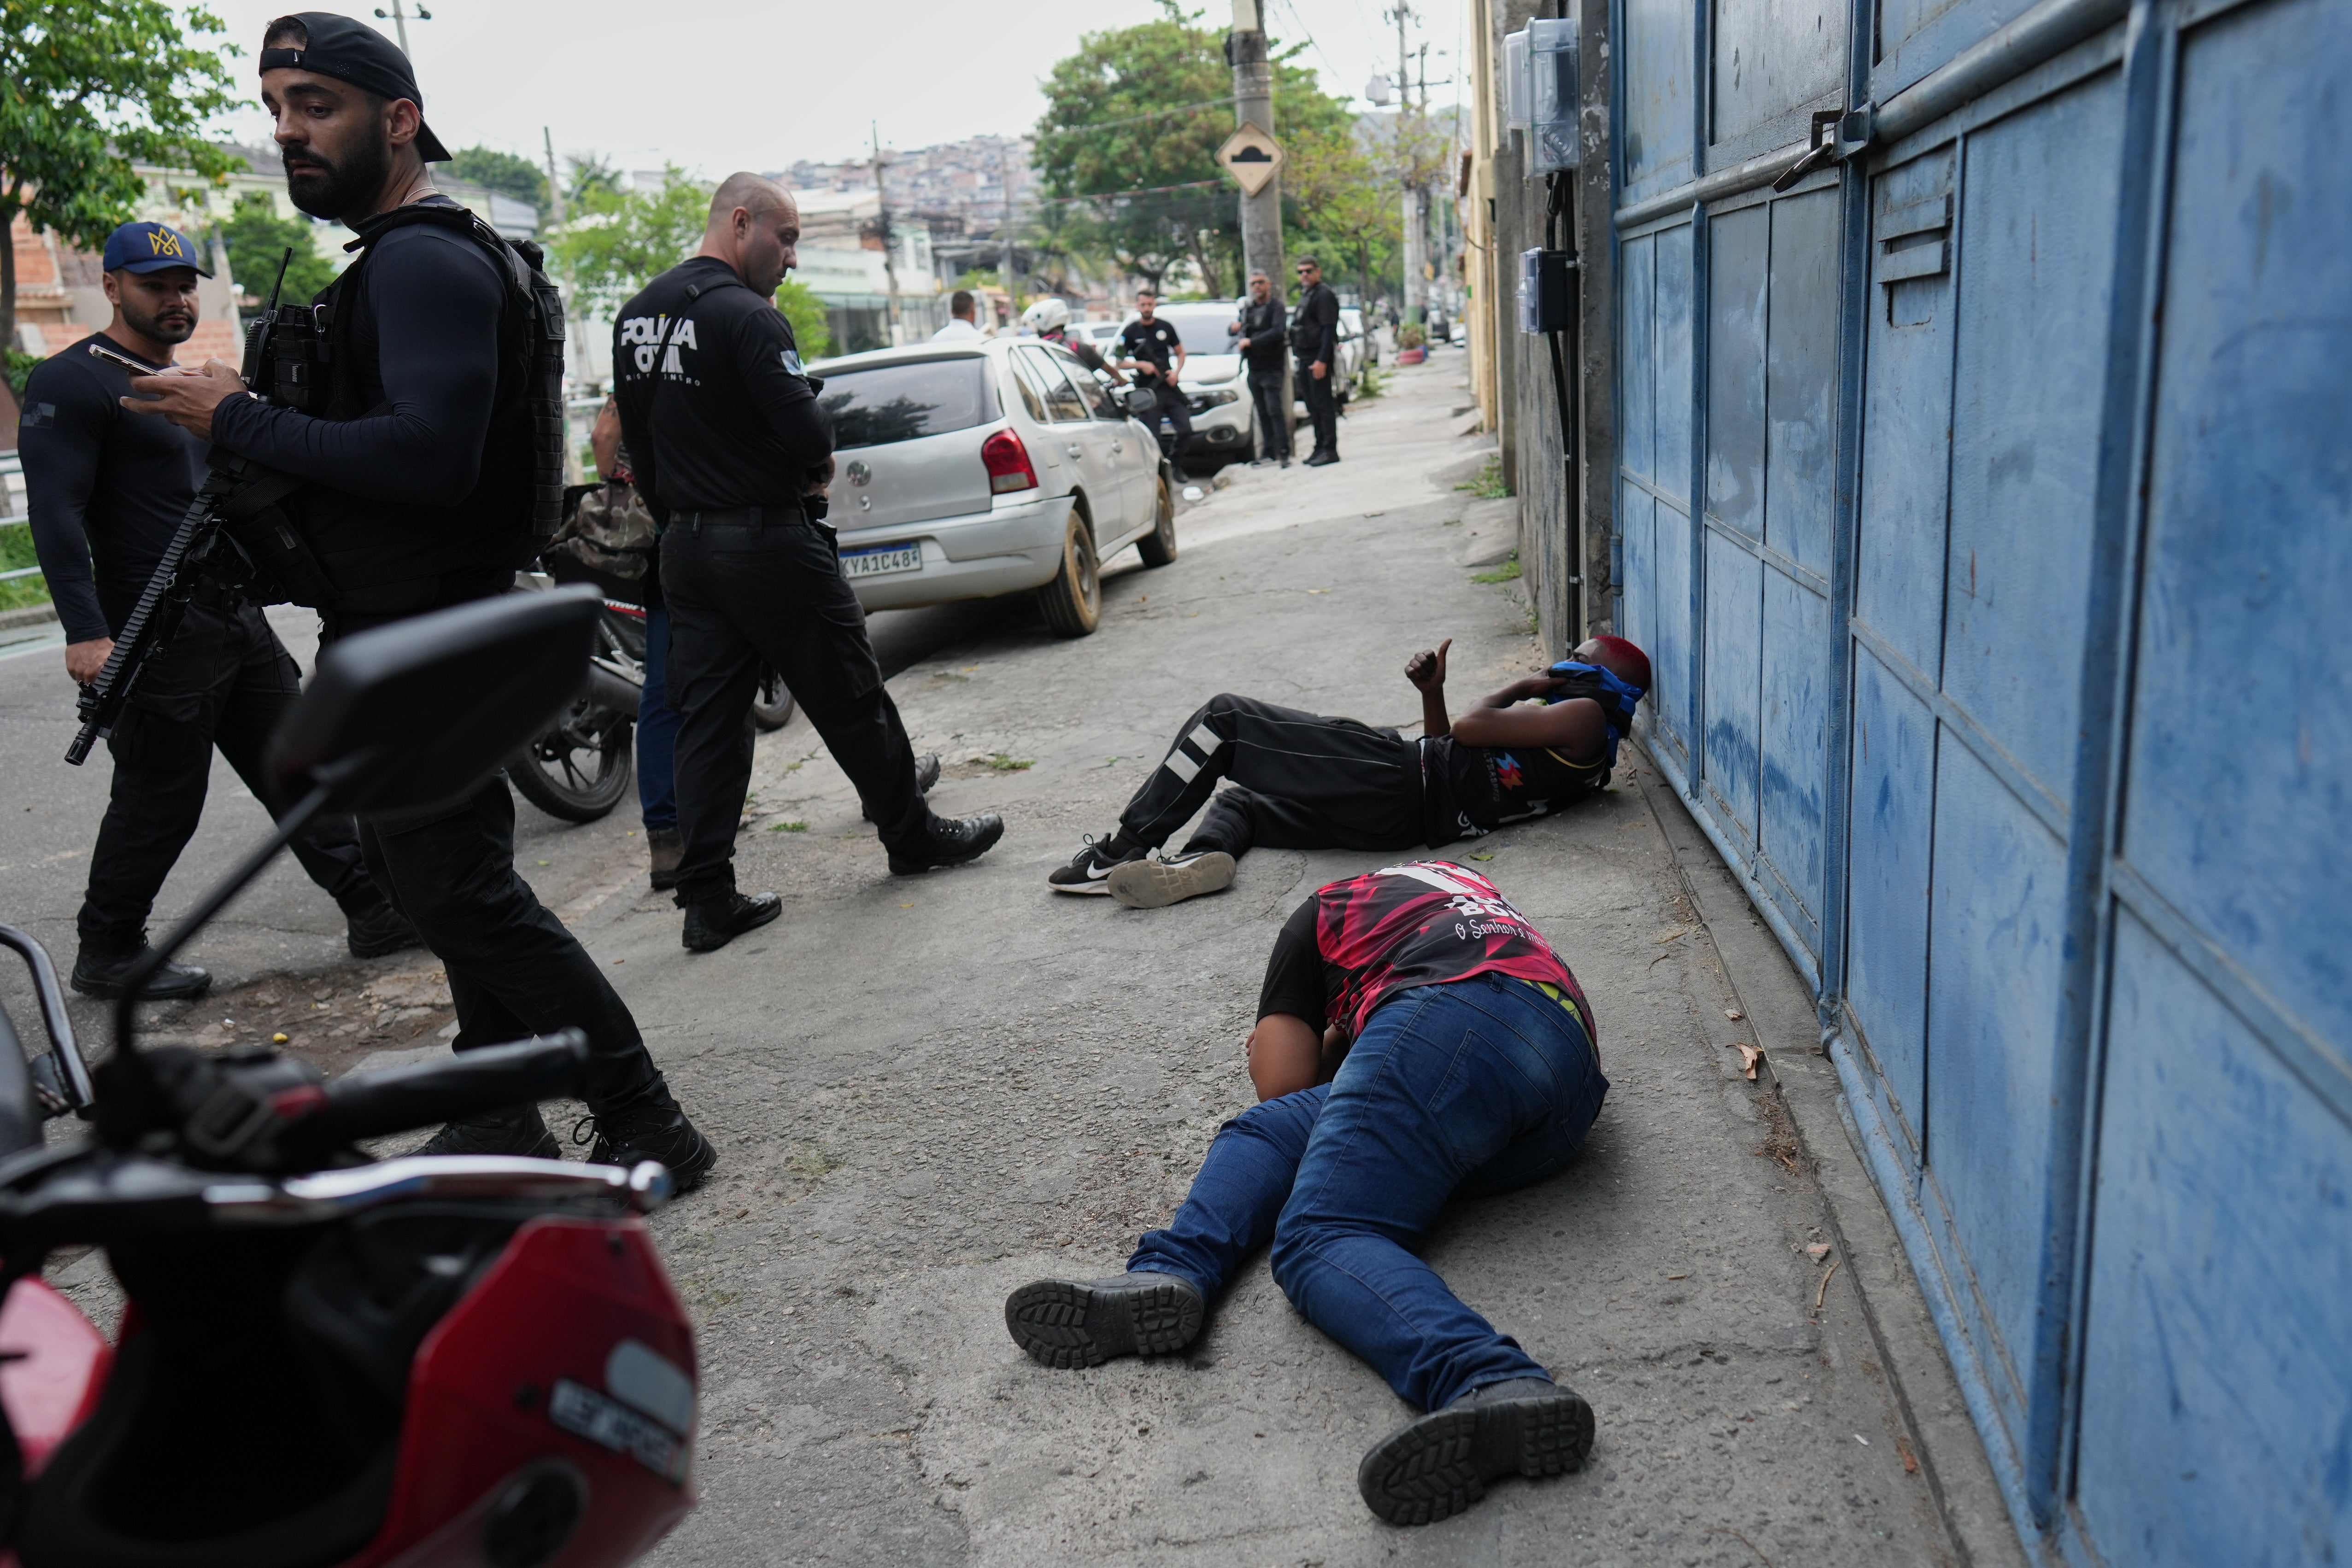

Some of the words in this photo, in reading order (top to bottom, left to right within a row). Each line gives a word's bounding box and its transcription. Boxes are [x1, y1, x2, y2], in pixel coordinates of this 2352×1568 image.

[621, 313, 698, 351] POLÍIA
[1469, 918, 1517, 939] Senhor
[1517, 924, 1526, 939] é
